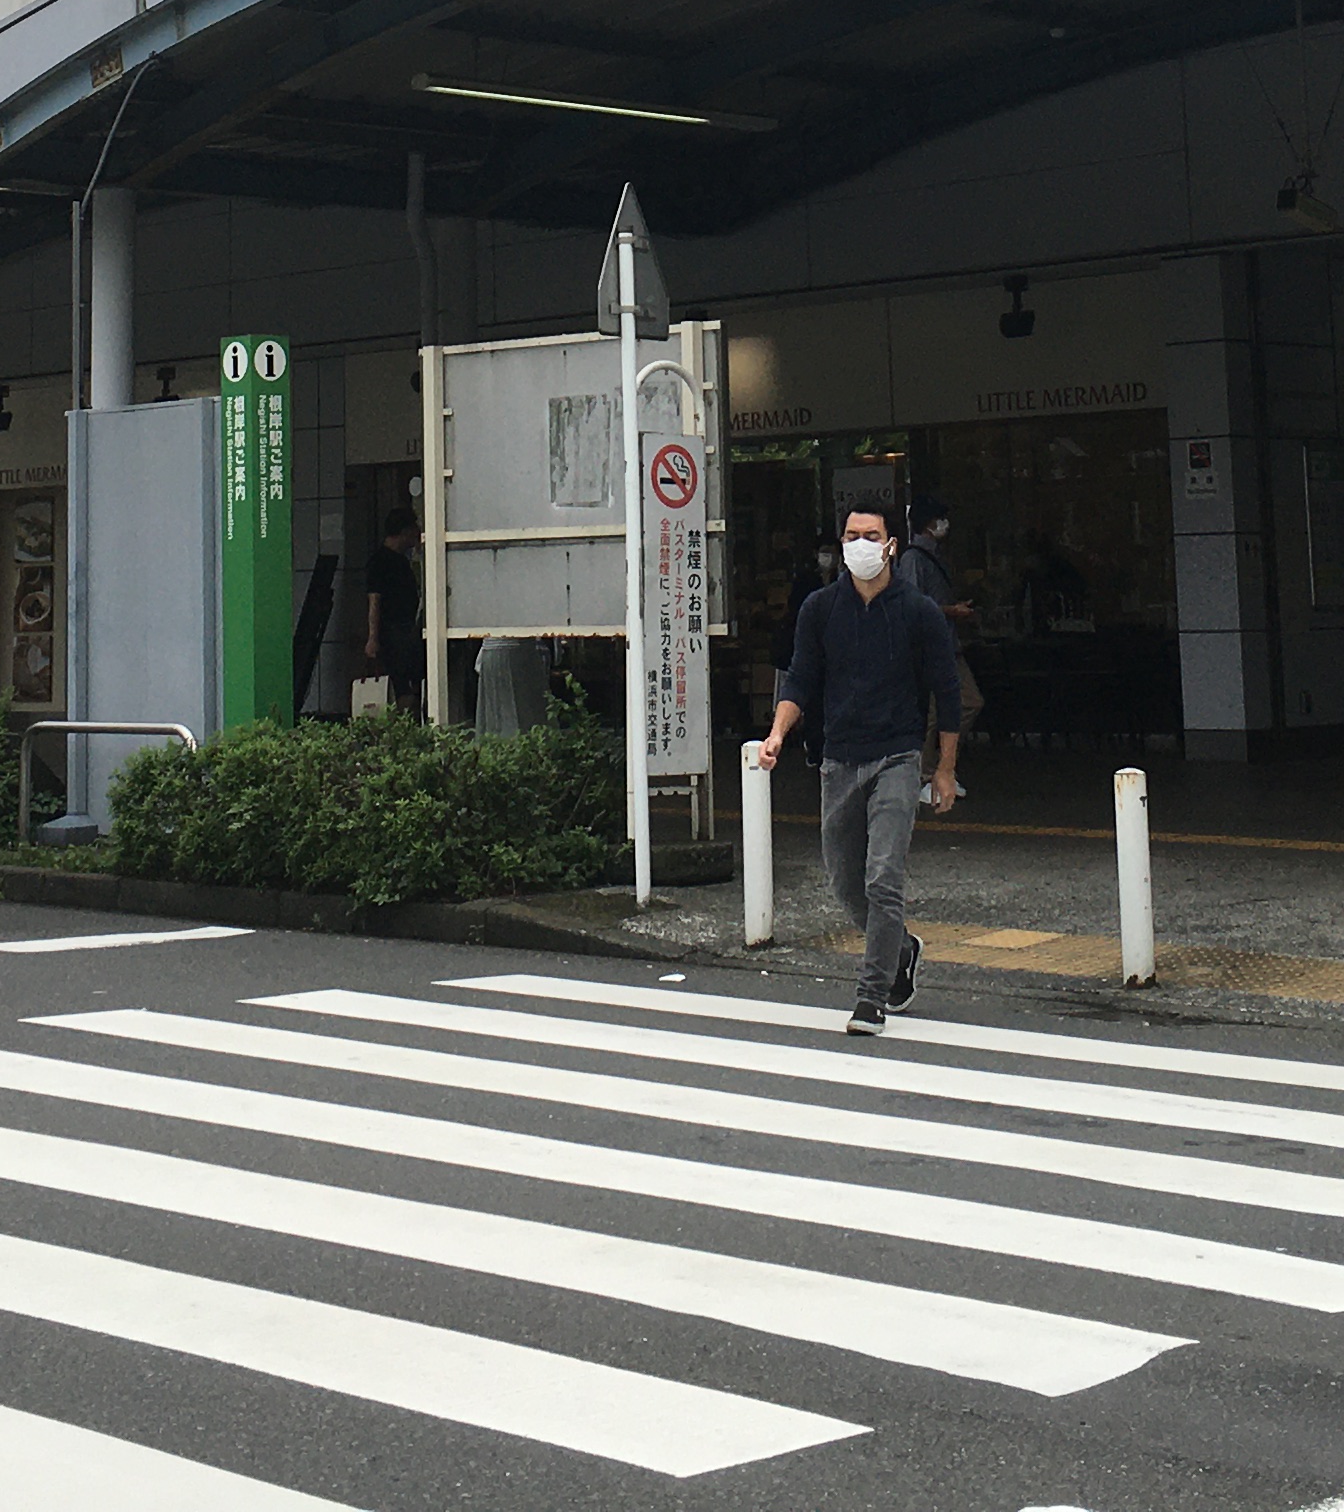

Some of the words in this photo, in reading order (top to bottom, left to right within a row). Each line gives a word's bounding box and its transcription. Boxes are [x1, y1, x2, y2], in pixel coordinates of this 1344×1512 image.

[225, 396, 233, 437] Negishi
[258, 394, 267, 435] Negishi
[977, 390, 1036, 412] LITTLE
[1043, 382, 1147, 410] MERMAID
[226, 440, 234, 477] Station
[233, 395, 246, 502] 根岸駅ご案内
[259, 437, 267, 475] Station
[268, 394, 283, 500] 根岸駅ご案内
[226, 479, 234, 540] Information
[687, 529, 702, 653] 禁煙のお願い
[659, 517, 672, 757] 全面禁煙に、ご協力をお願いします。
[674, 518, 687, 739] バスターミナル・バス停留所での
[647, 669, 658, 757] 横浜市交通局
